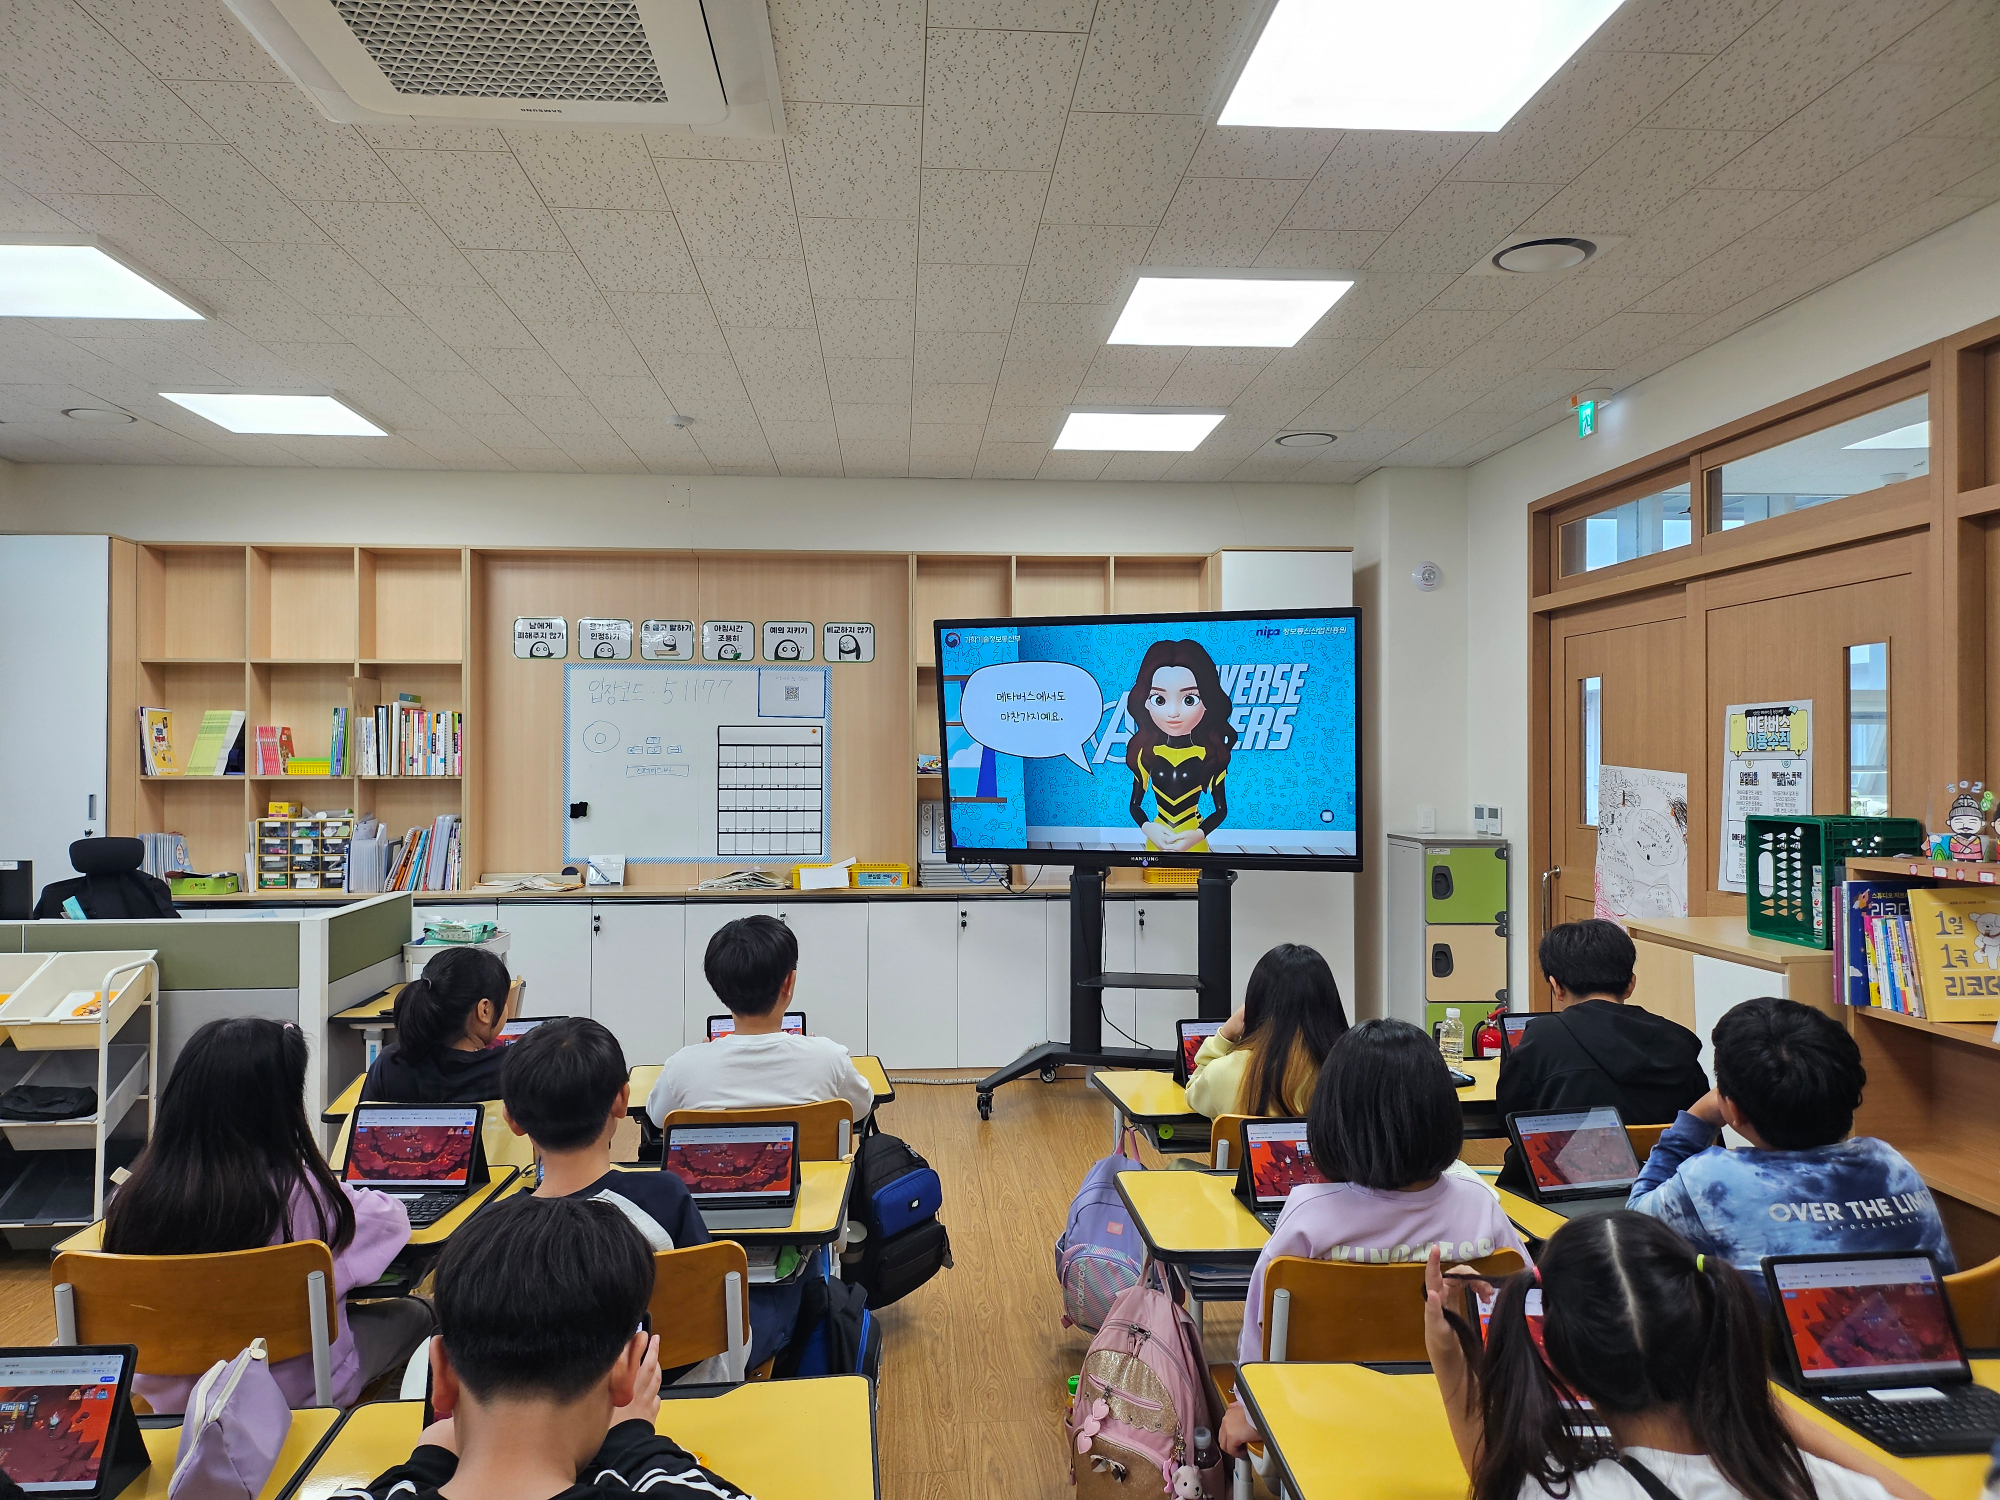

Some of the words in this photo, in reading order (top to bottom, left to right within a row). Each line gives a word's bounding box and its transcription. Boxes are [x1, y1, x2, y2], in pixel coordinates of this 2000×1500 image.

[529, 622, 553, 630] 남에게
[669, 624, 692, 632] 말하기
[713, 624, 744, 633] 아침시간
[769, 626, 785, 635] 예의
[787, 626, 808, 635] 지키기
[826, 626, 855, 635] 비교하지
[857, 626, 872, 635] 않기
[1283, 626, 1347, 636] 정보통신산업진흥원
[517, 632, 547, 640] 피해주지
[549, 632, 565, 640] 않기
[590, 632, 620, 641] 인정하기
[1255, 626, 1280, 638] nipa
[717, 635, 740, 643] 조용히
[964, 635, 1021, 644] 과학기술정보통신부
[588, 677, 646, 705] 입장코드
[662, 677, 733, 704] 51177
[996, 691, 1066, 702] 메타버스에서도
[1000, 711, 1064, 723] 마찬가지예요.
[1746, 714, 1791, 733] 메타버스
[1746, 731, 1791, 751] 이용수칙
[1935, 910, 1965, 936] 1일
[1940, 943, 1969, 969] 1곡
[1769, 1203, 1844, 1222] OVER
[1845, 1198, 1893, 1219] THE
